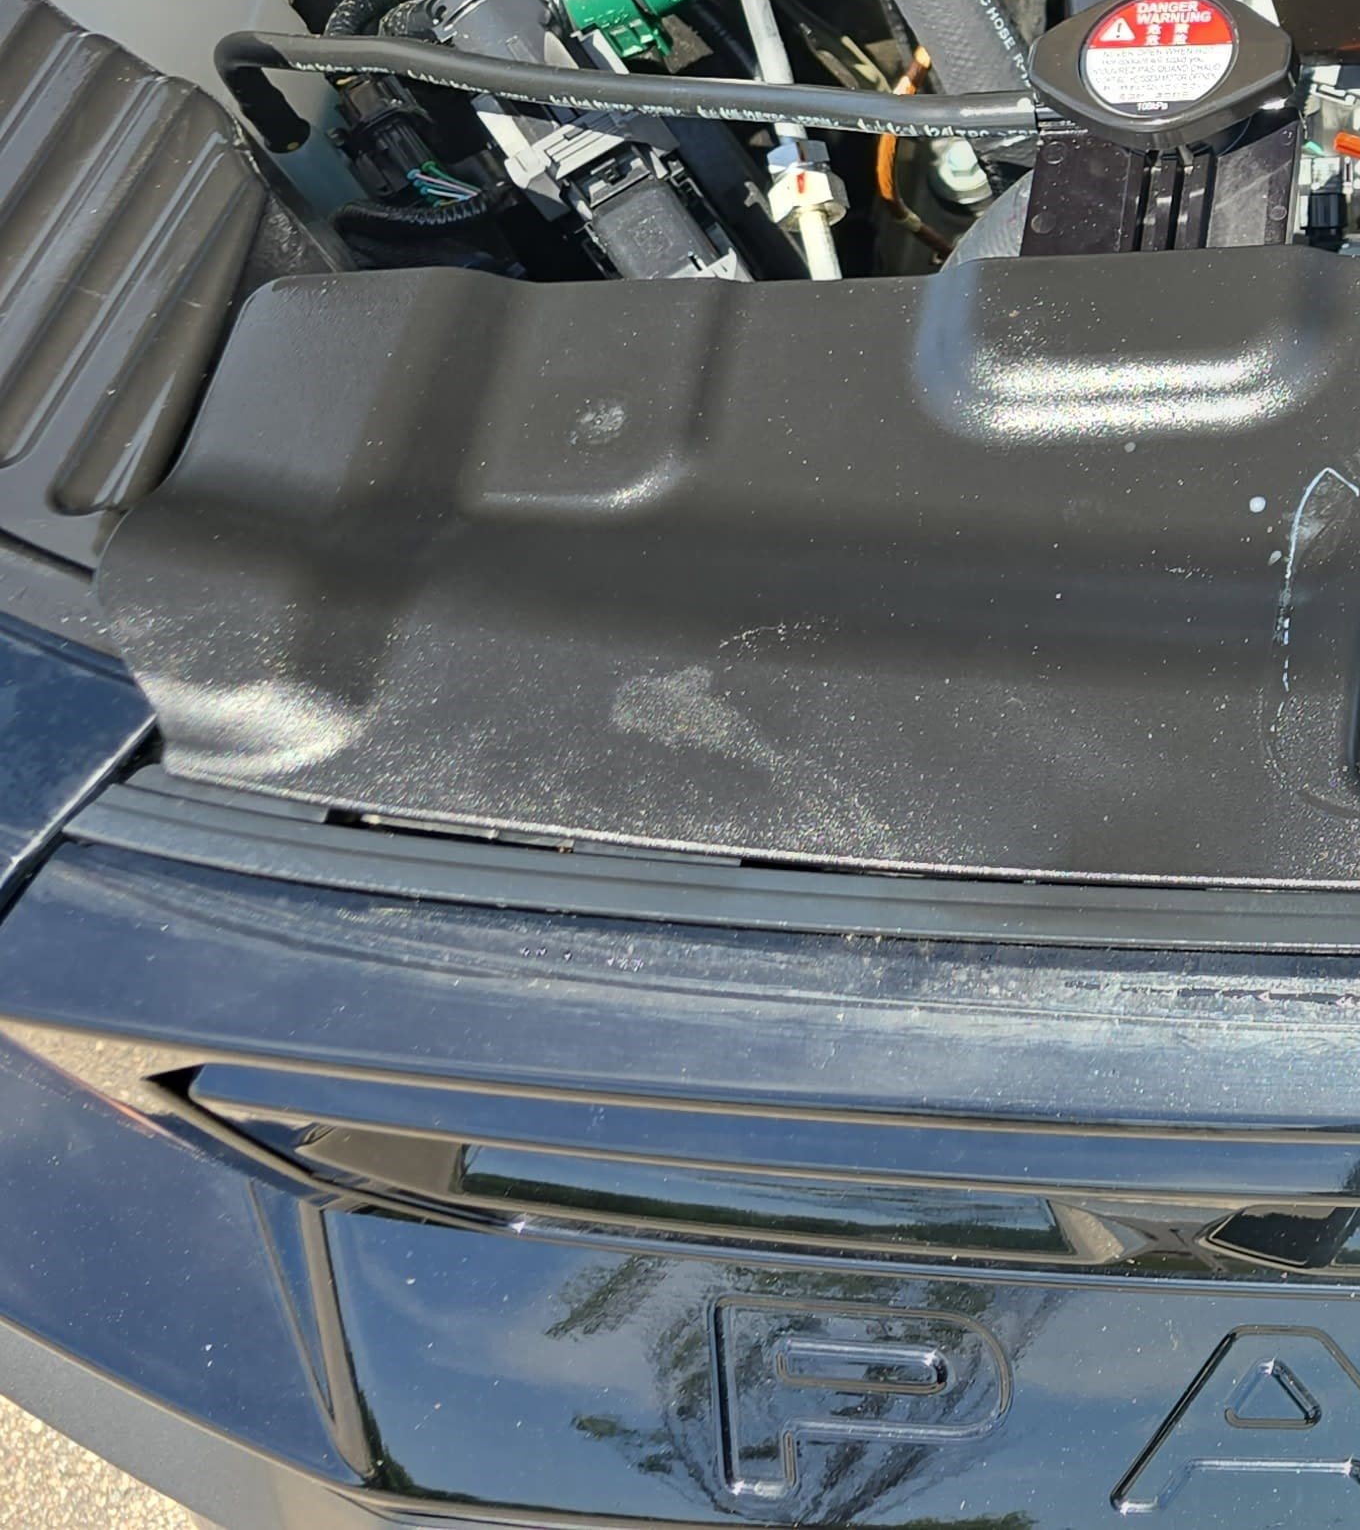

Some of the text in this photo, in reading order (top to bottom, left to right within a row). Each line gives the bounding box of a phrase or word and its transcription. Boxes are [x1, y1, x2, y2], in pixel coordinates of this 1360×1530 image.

[1136, 1, 1199, 13] DANGER
[1136, 11, 1212, 24] WARNUNG
[985, 6, 1016, 51] HOSE
